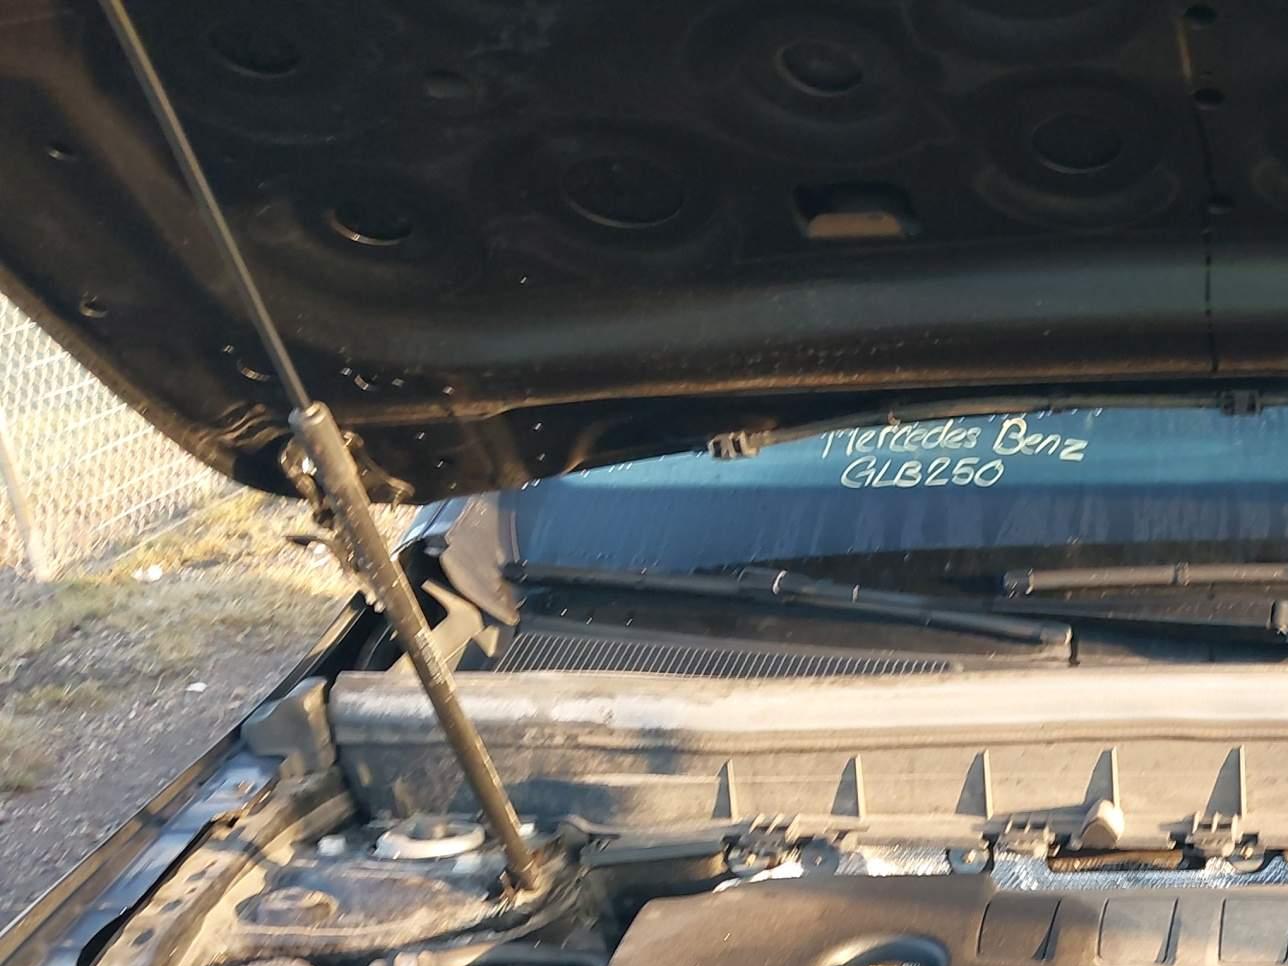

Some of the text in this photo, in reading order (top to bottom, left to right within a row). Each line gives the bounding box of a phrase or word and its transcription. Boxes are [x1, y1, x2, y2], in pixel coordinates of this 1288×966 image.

[821, 418, 1089, 461] Mercedes Benz
[841, 456, 1006, 488] GLB250
